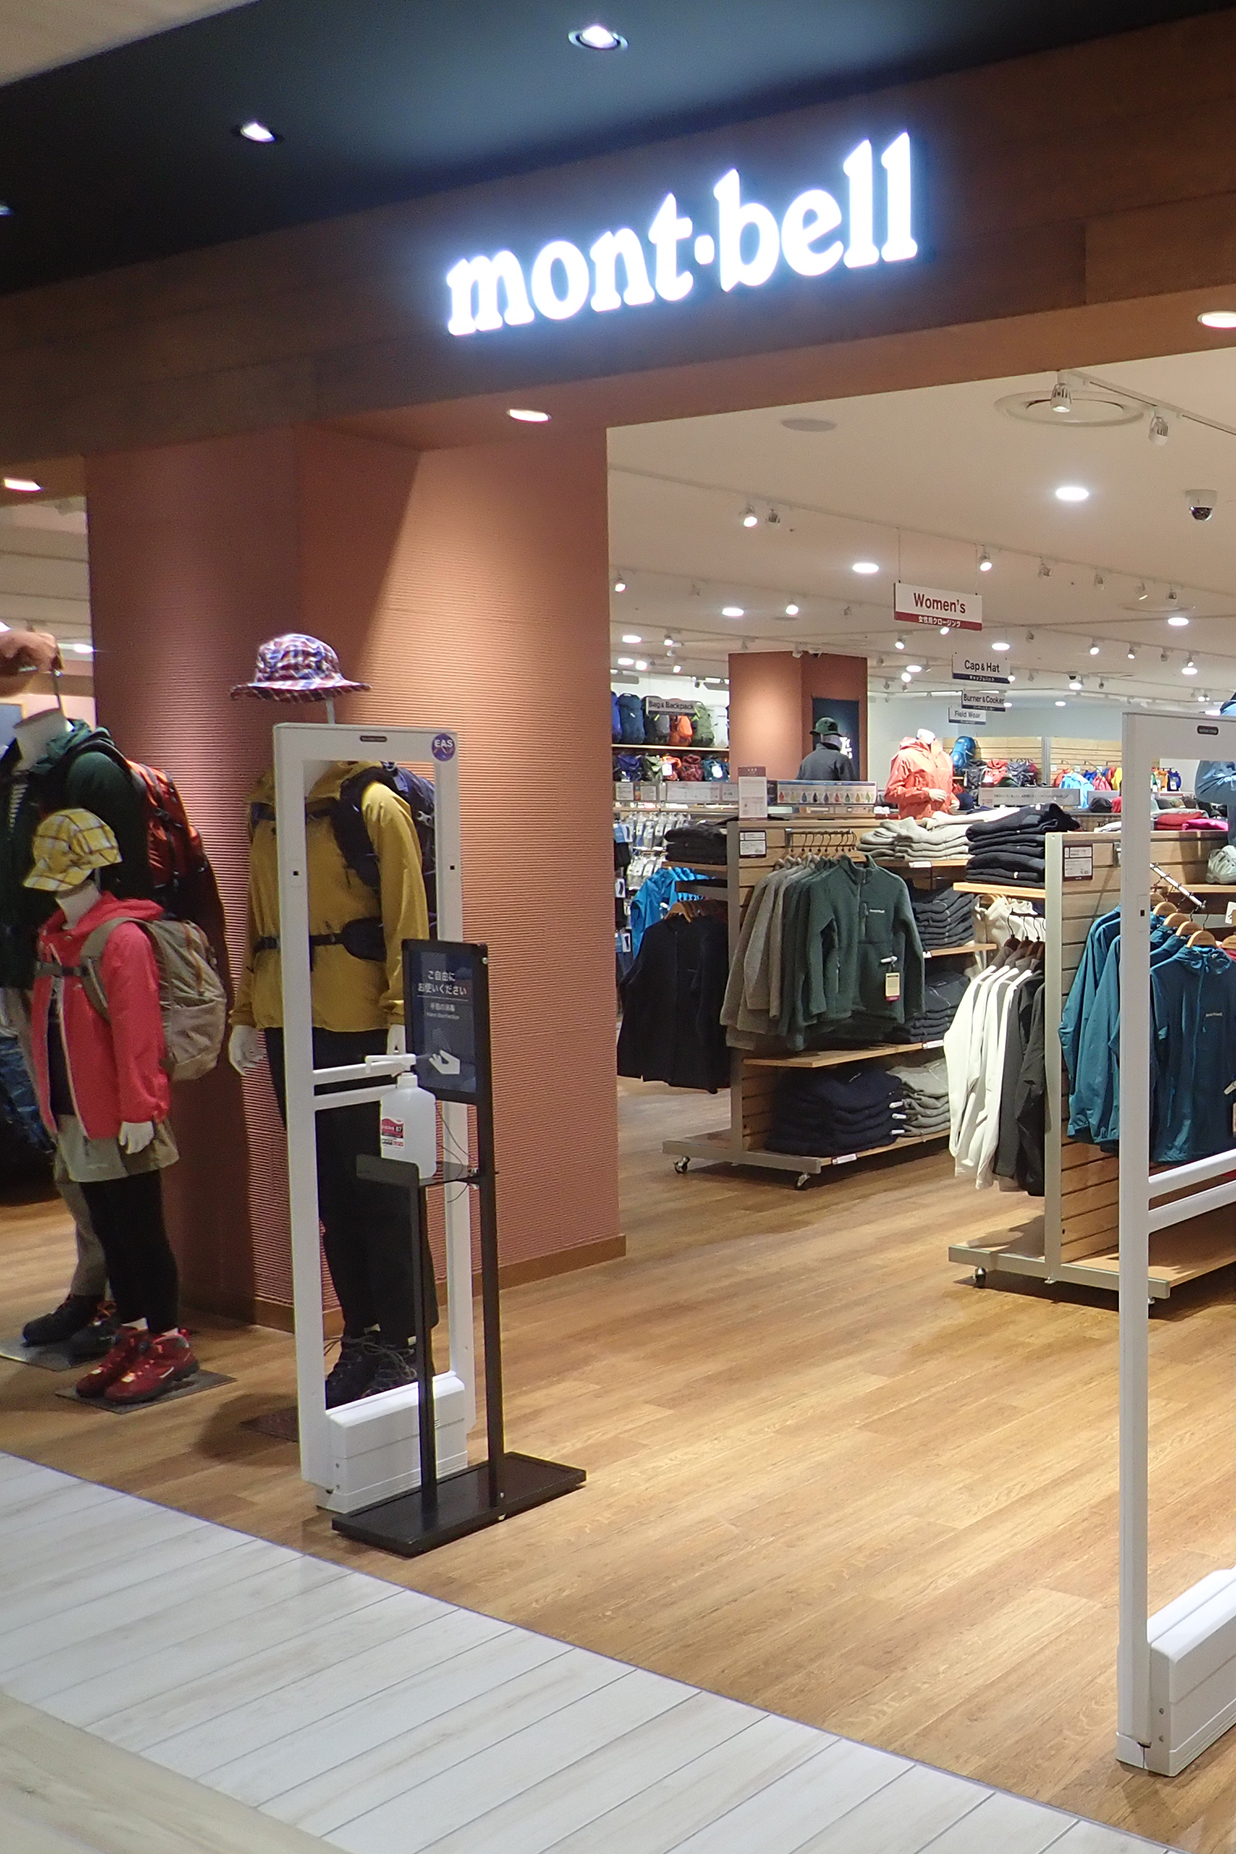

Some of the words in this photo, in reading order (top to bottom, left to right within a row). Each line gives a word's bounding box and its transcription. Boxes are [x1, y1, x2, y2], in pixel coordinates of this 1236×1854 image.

[913, 592, 966, 614] Women's
[964, 659, 980, 672] Cap
[986, 662, 1000, 673] Hat
[963, 694, 981, 703] Burner
[986, 695, 1005, 705] Cooker
[648, 701, 660, 709] Bag
[665, 701, 694, 710] Backpack
[954, 710, 967, 718] Field
[968, 711, 981, 719] Wear
[434, 739, 453, 748] EAS
[418, 983, 466, 995] お使いください
